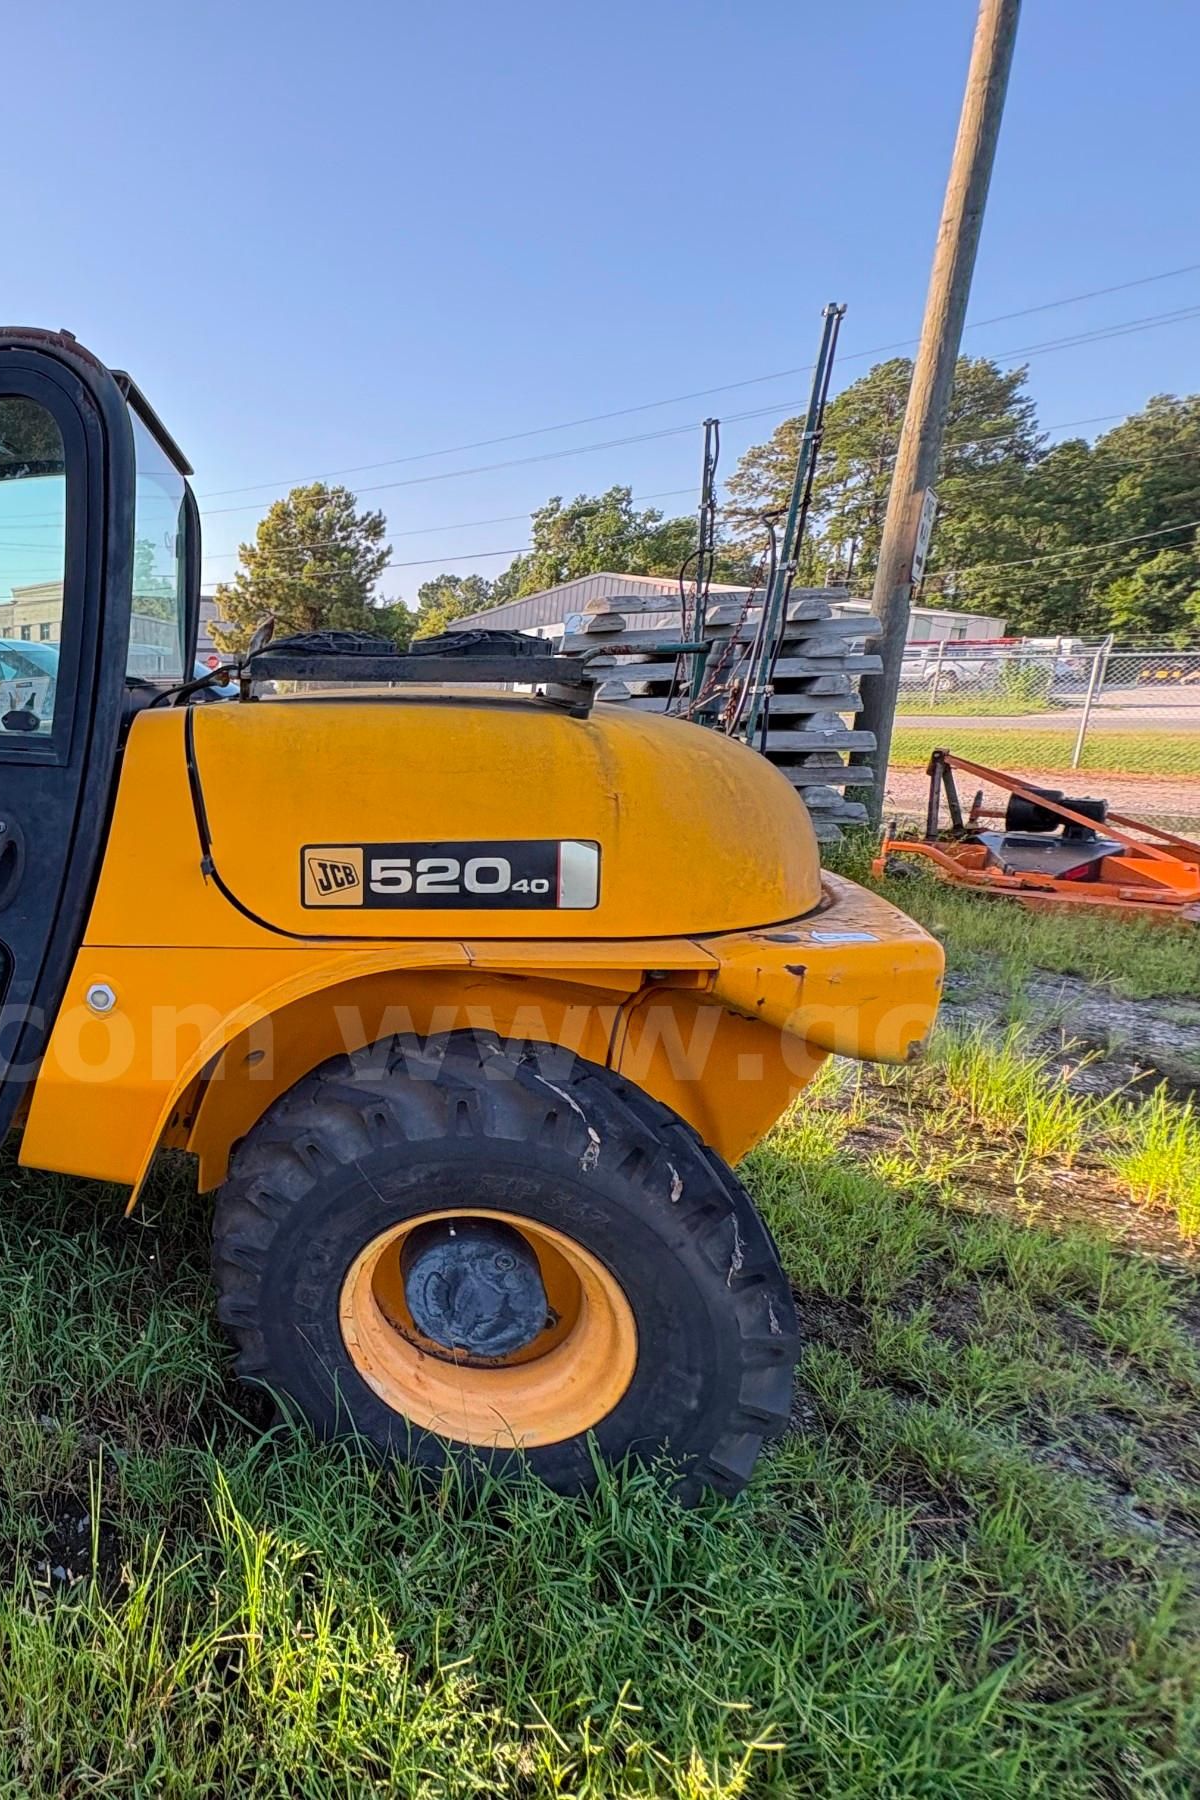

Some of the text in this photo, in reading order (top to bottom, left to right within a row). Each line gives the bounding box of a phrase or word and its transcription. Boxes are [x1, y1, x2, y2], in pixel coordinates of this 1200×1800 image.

[318, 857, 549, 894] JCB 520 40
